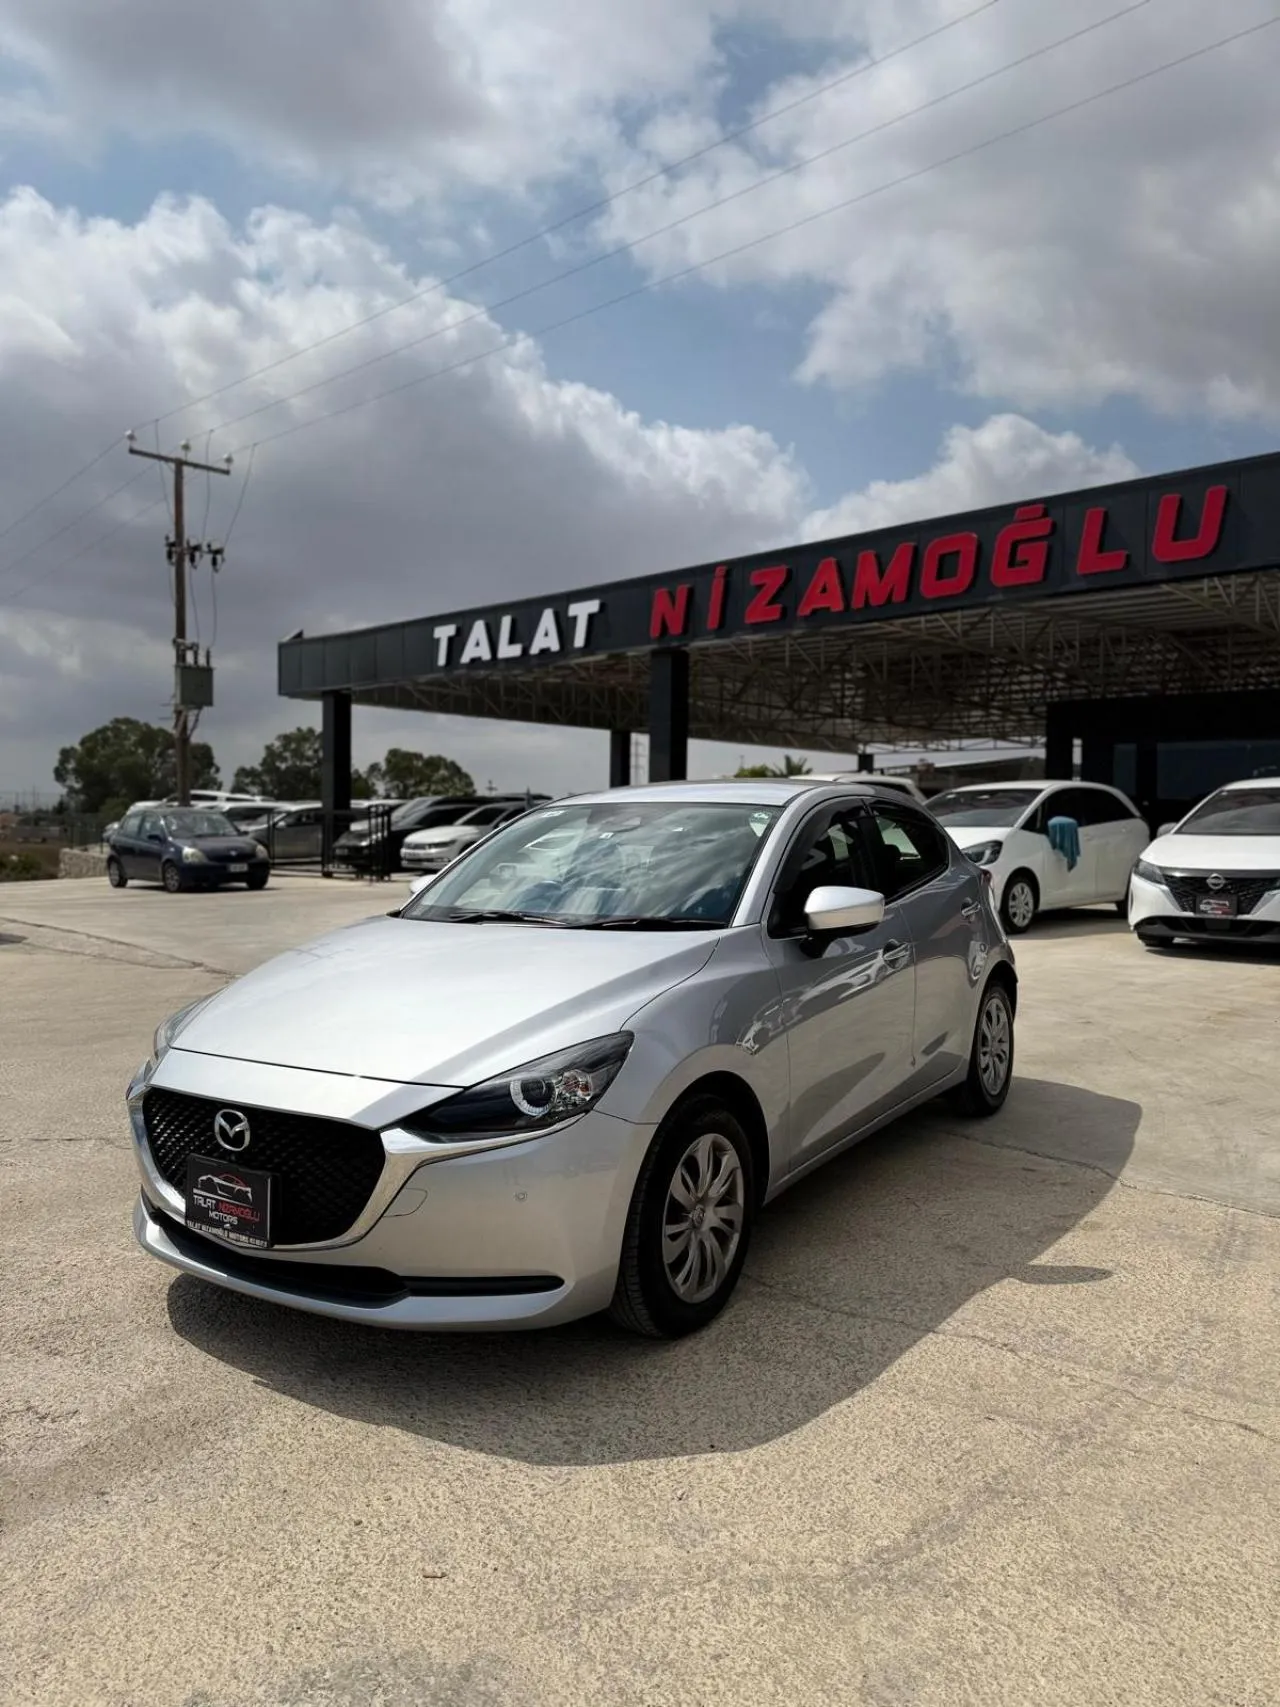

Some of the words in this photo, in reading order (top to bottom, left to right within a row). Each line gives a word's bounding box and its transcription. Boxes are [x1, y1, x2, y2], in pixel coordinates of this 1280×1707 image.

[433, 599, 600, 666] TALAT
[650, 485, 1228, 639] NİZAMOĞLU
[193, 1195, 216, 1210] TALAT
[209, 1210, 238, 1225] MOTORS
